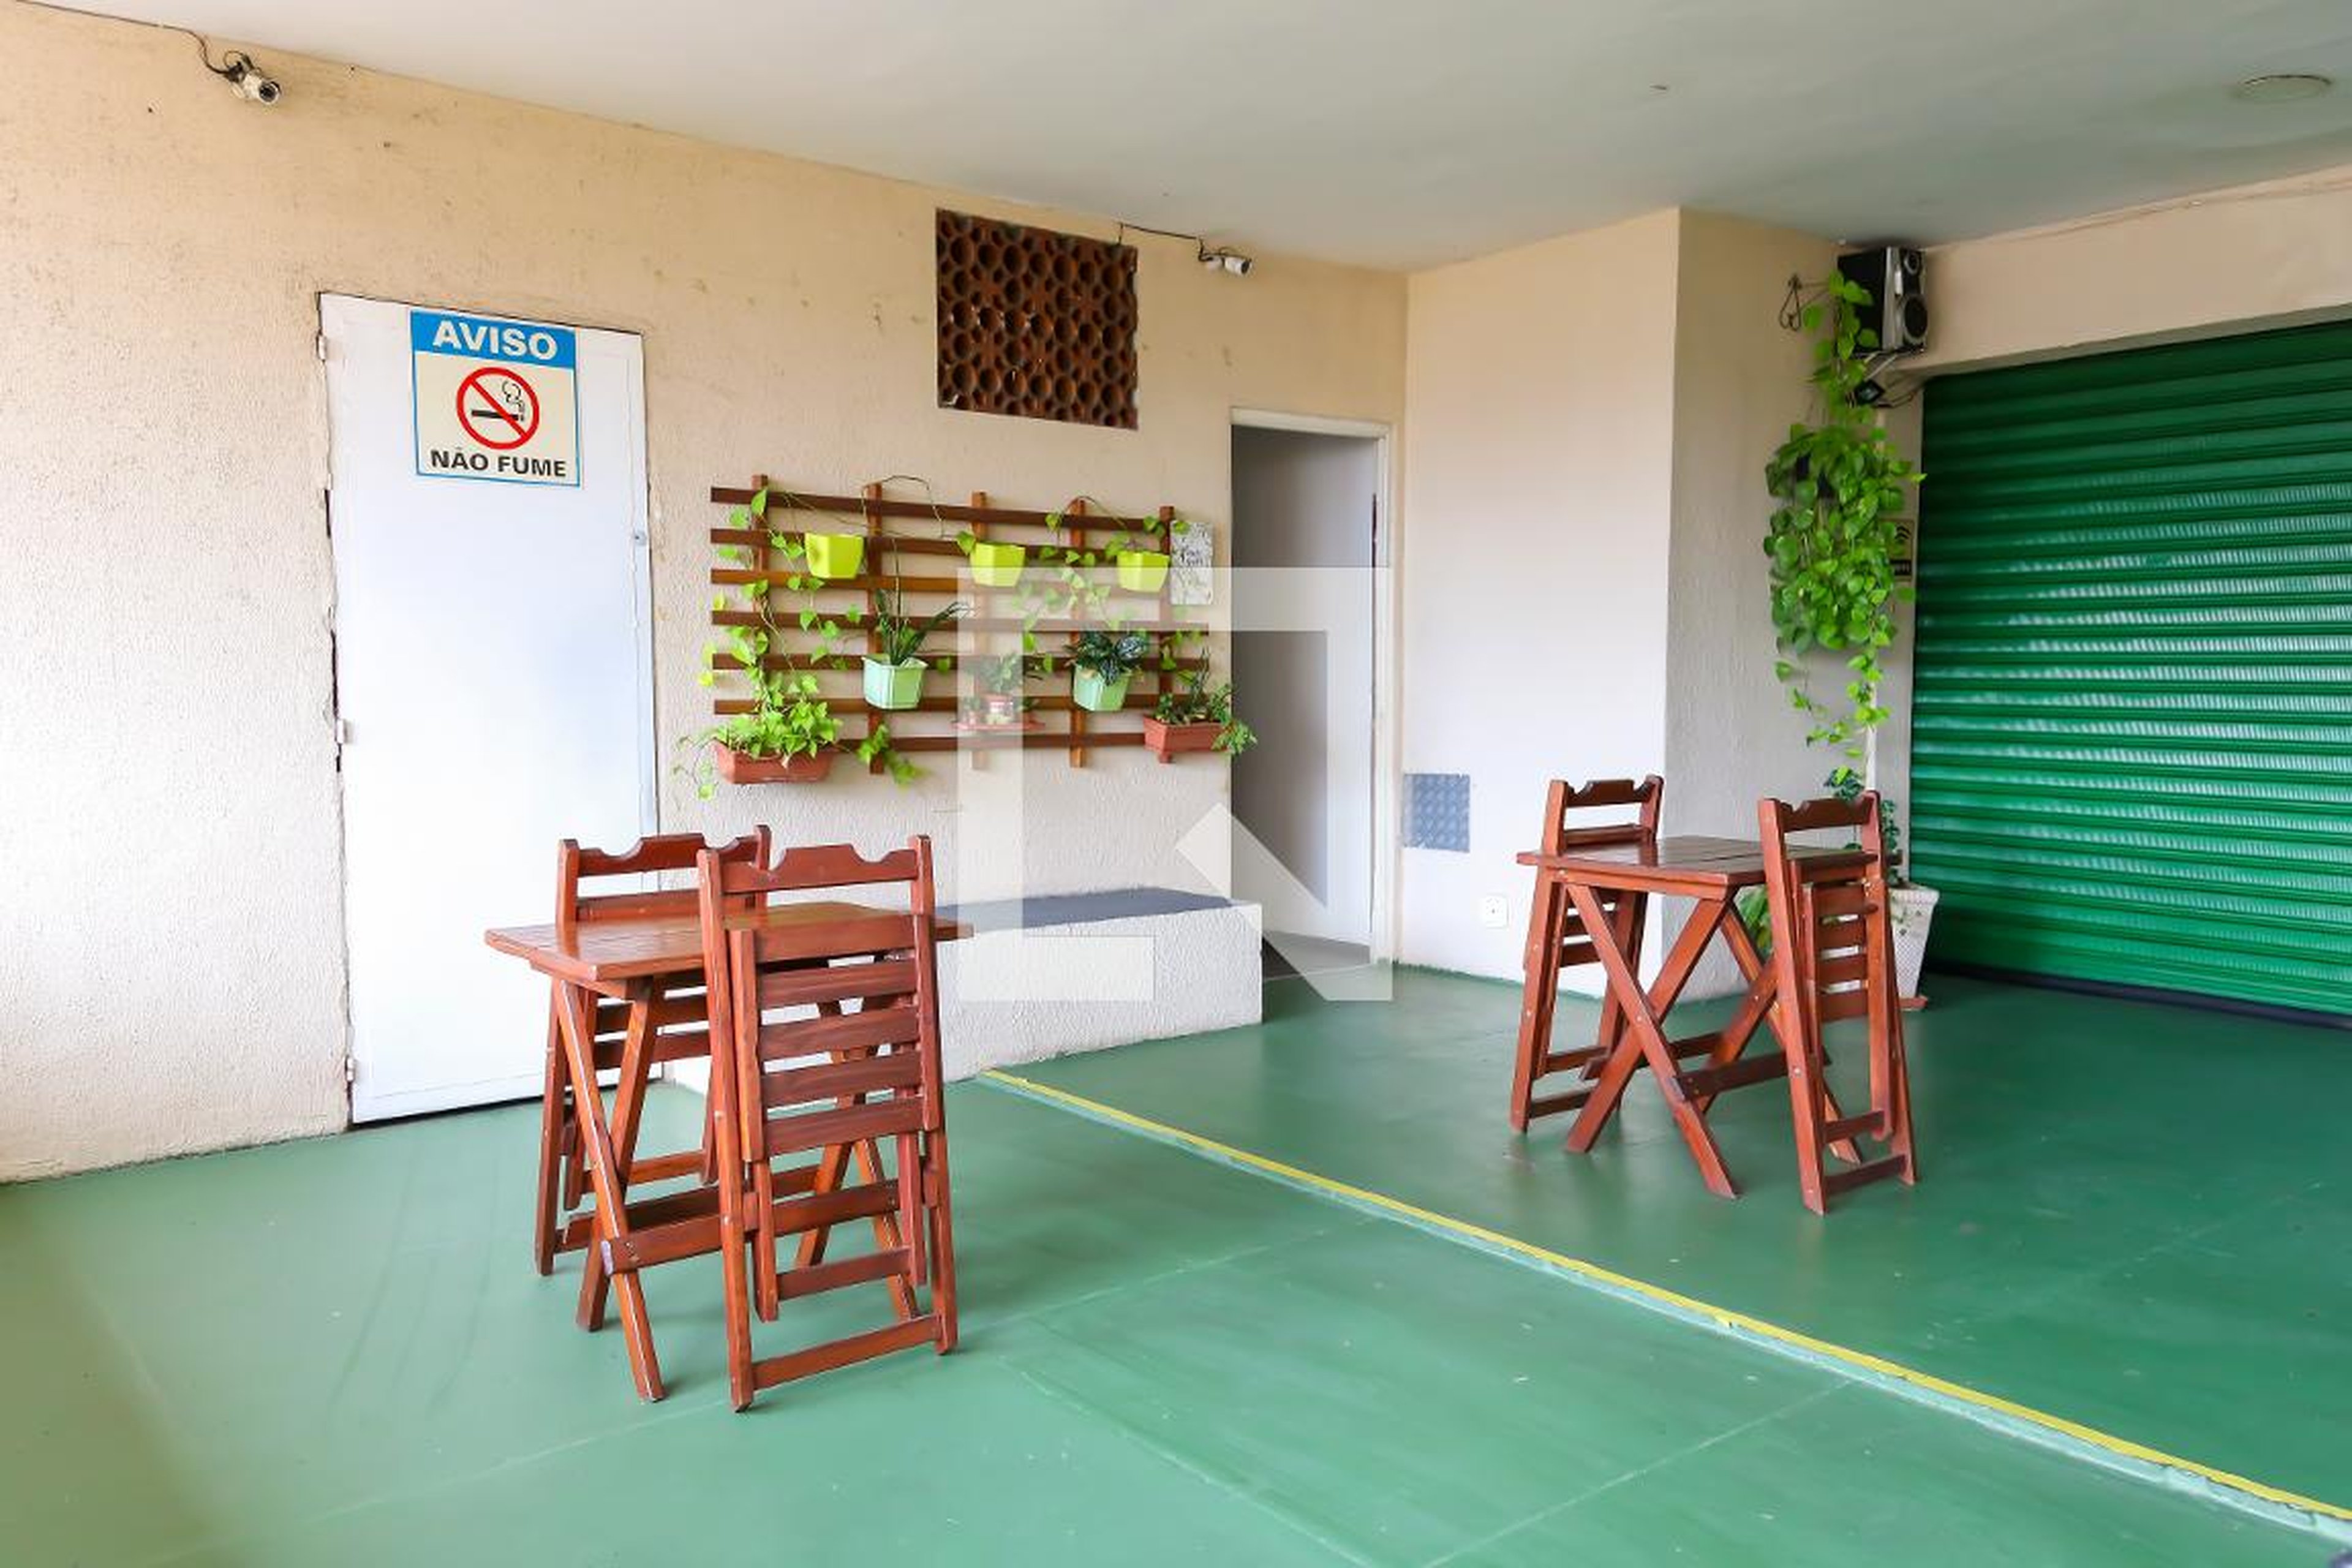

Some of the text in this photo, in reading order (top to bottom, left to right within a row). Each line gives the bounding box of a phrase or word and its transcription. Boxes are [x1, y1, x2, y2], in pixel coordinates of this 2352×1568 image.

[432, 320, 557, 360] AVISO
[430, 447, 567, 477] NÃO FUME
